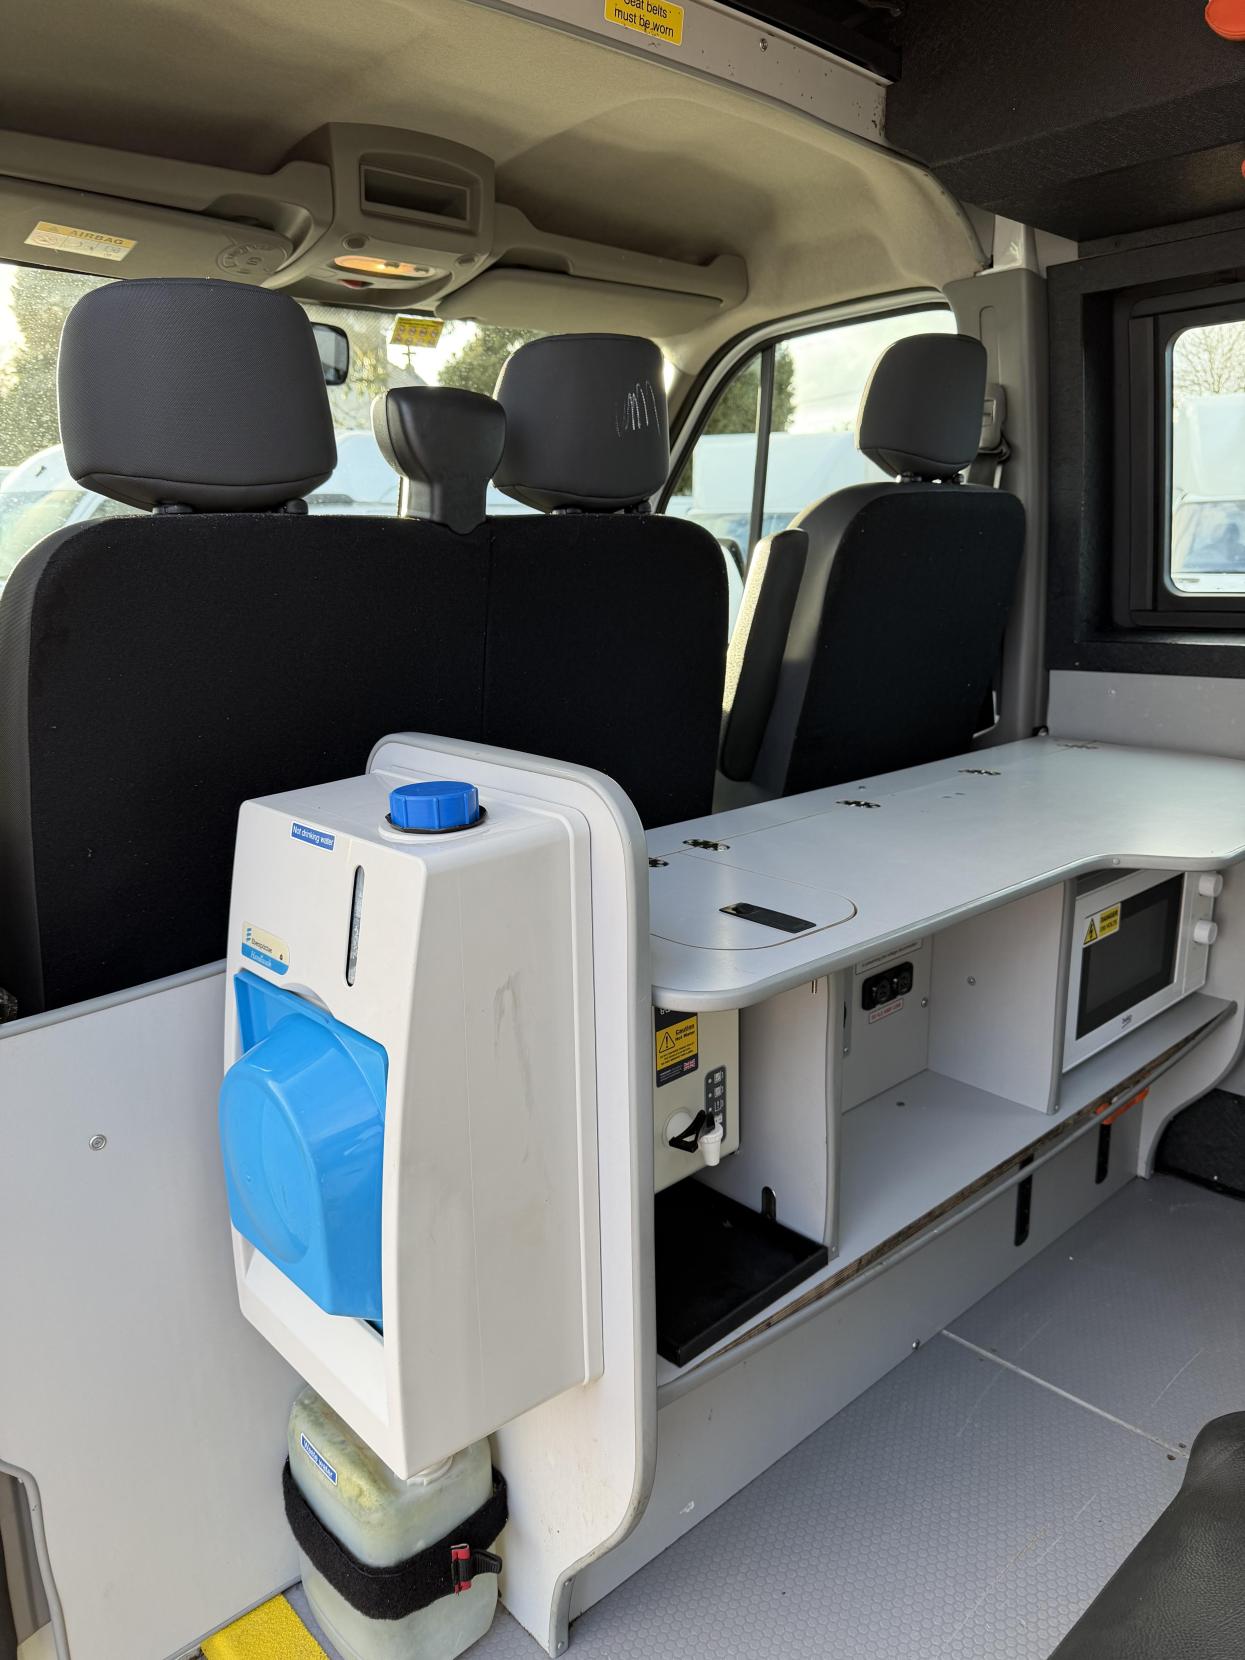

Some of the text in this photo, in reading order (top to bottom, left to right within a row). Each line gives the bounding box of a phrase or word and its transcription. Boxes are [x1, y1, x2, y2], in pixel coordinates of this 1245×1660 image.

[646, 1, 668, 18] belts
[614, 7, 674, 38] must be worn
[69, 230, 123, 245] AIRBAG
[293, 824, 302, 835] Not
[301, 828, 320, 844] drinking
